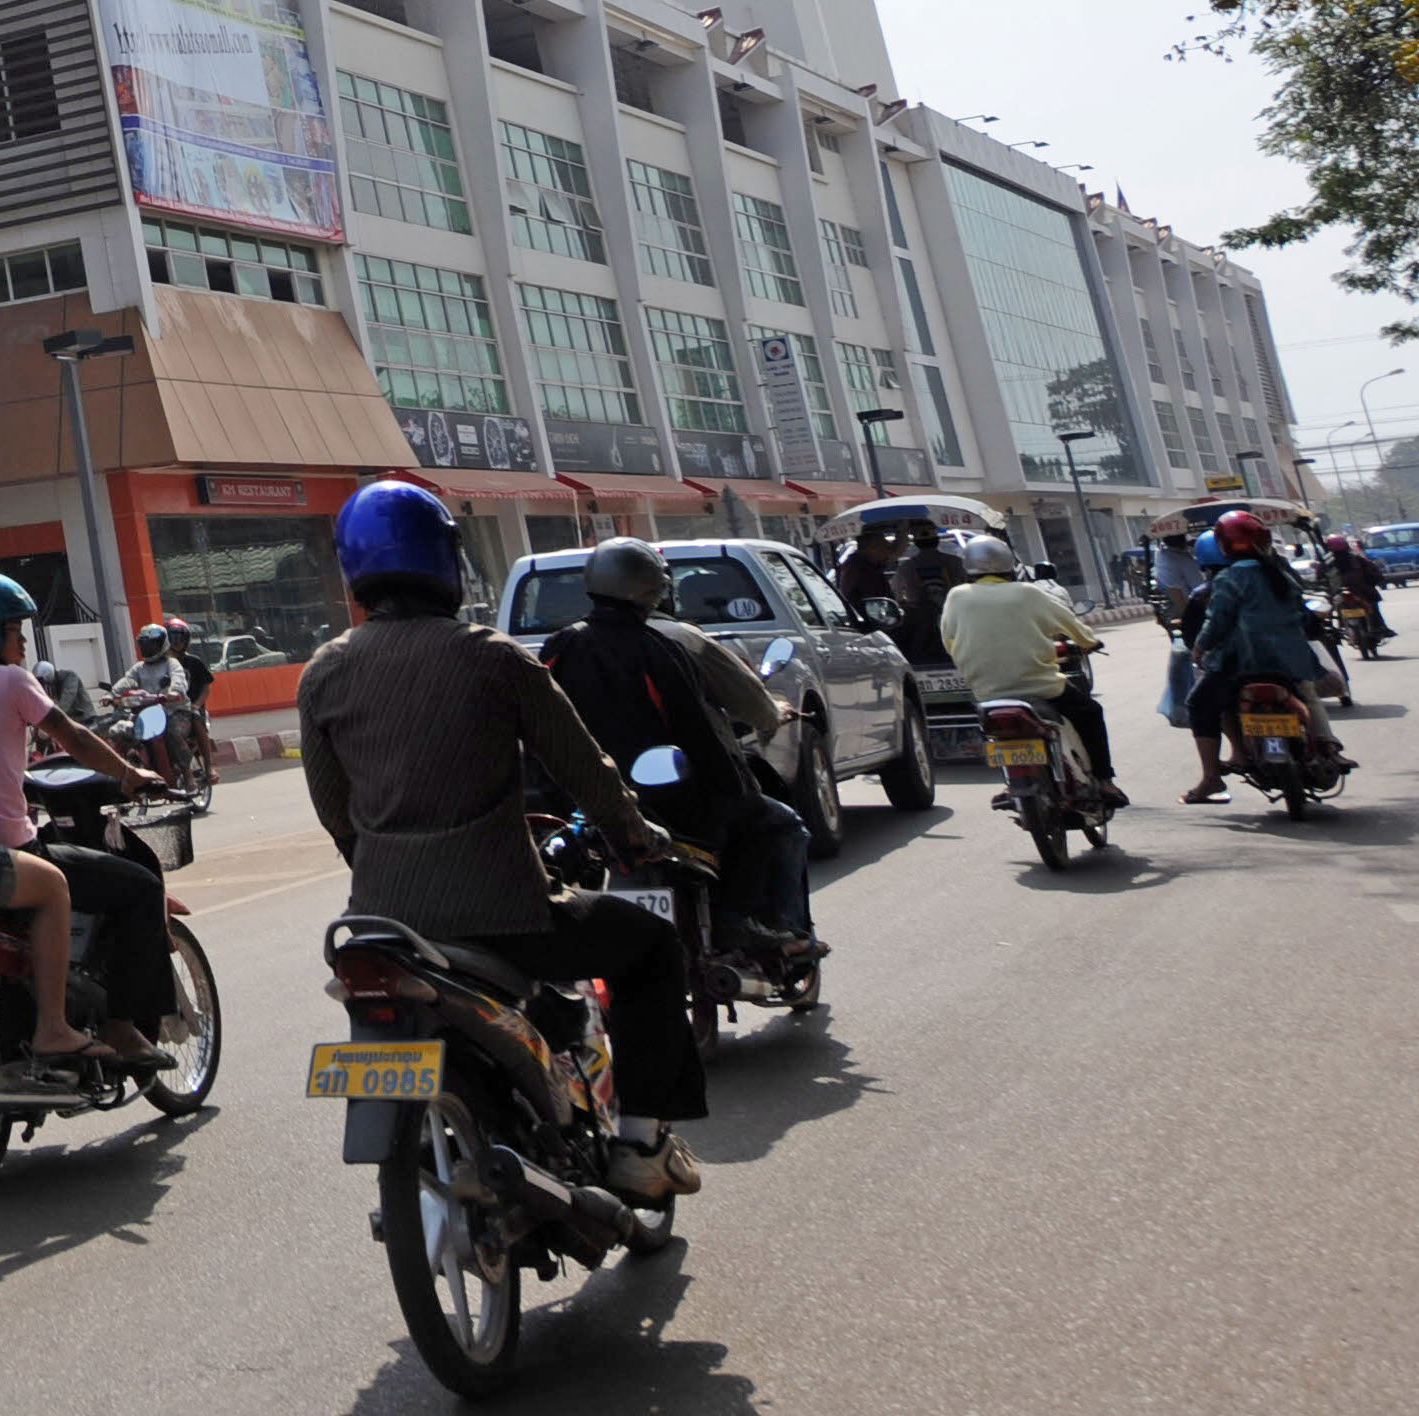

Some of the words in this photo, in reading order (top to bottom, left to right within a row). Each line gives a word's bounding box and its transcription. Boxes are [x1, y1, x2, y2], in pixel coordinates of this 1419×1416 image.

[237, 484, 293, 498] RESTAURANT
[733, 600, 756, 617] LAO
[363, 1067, 436, 1095] 0985
